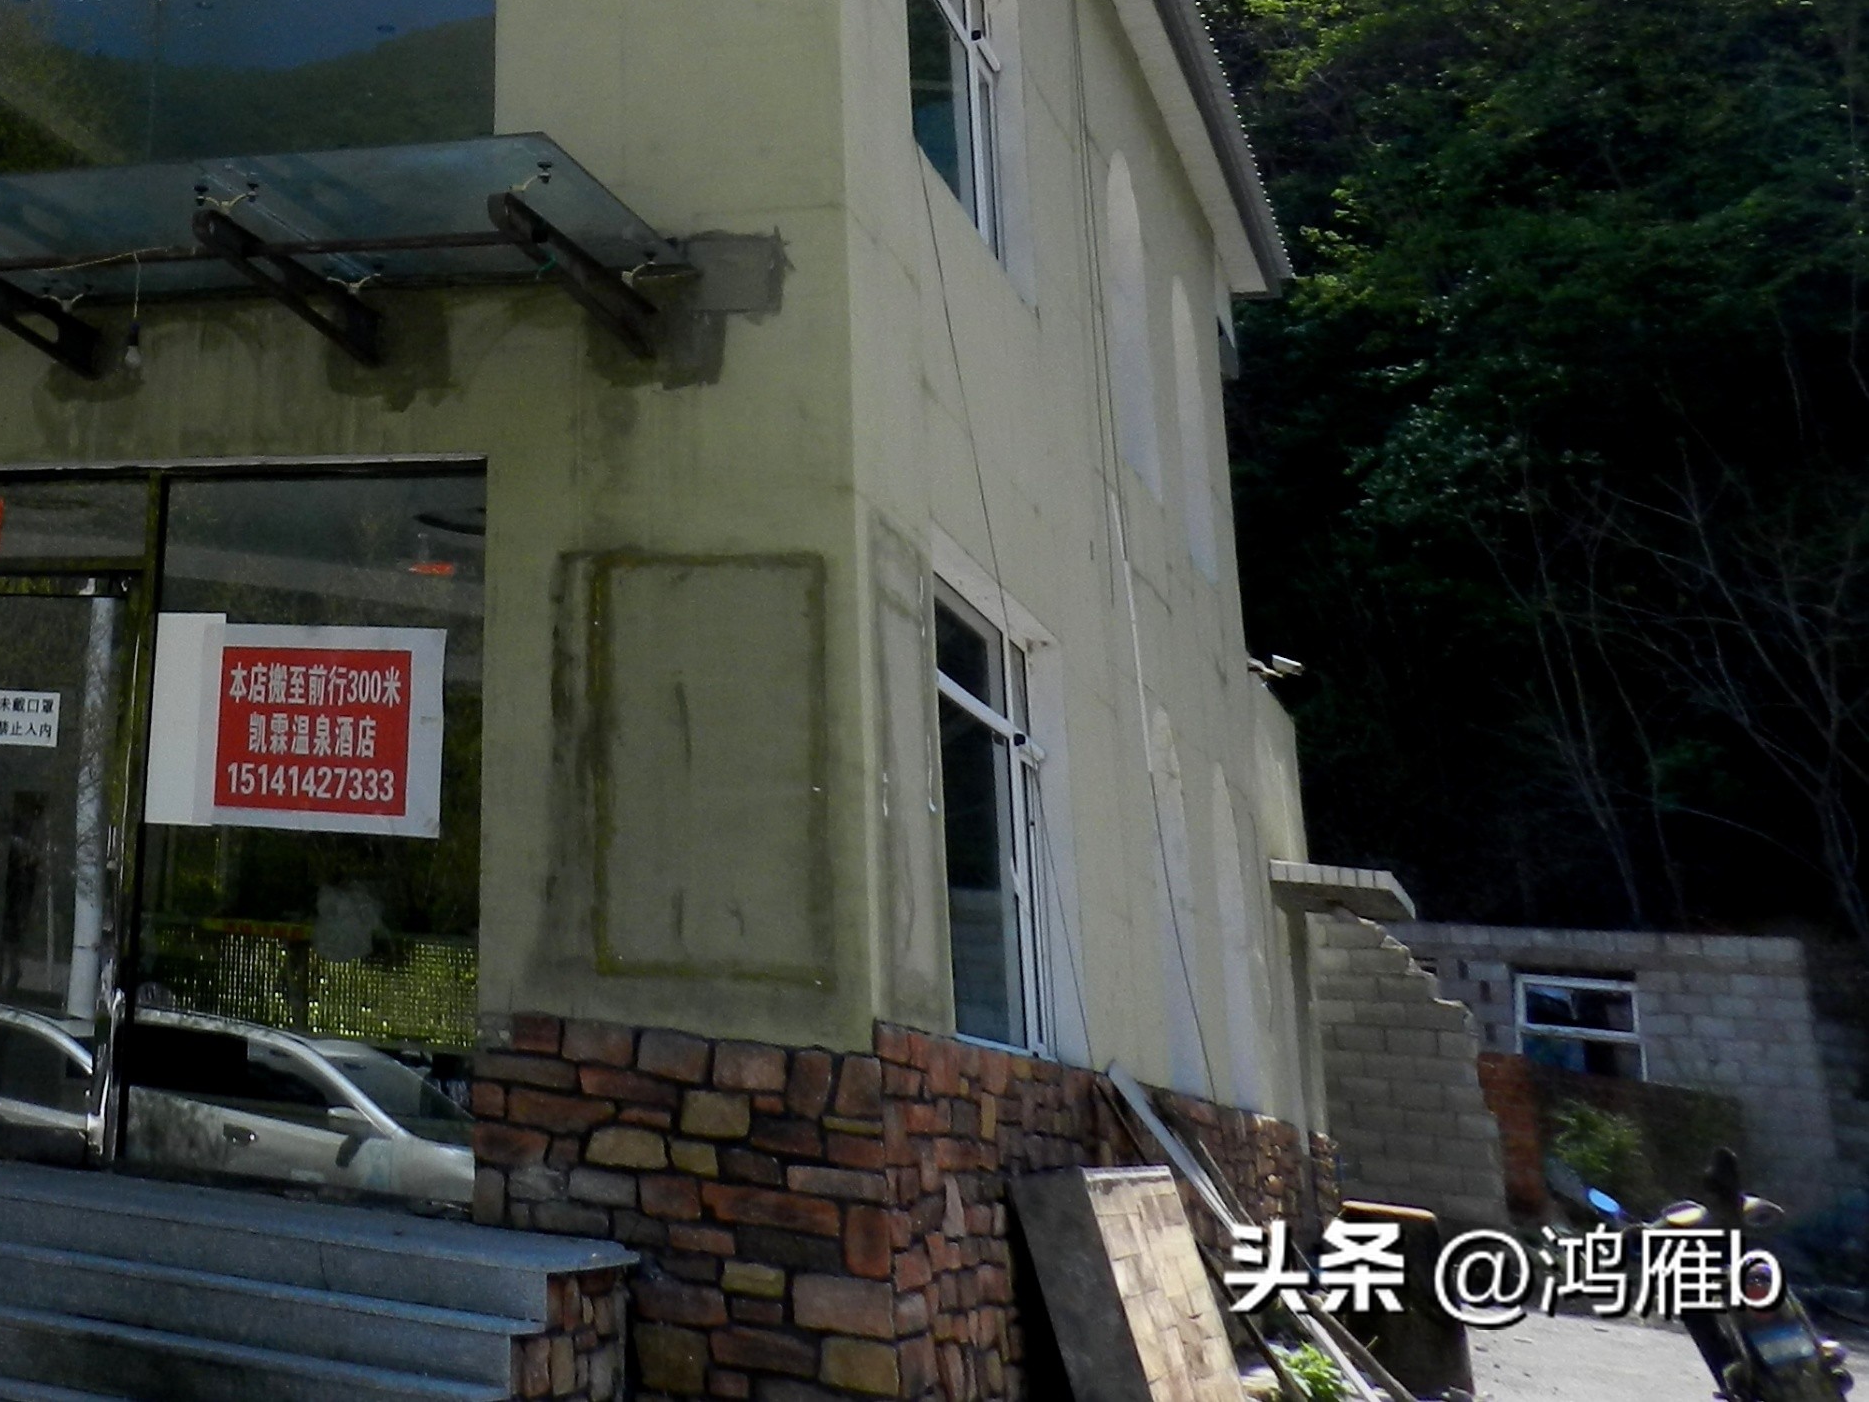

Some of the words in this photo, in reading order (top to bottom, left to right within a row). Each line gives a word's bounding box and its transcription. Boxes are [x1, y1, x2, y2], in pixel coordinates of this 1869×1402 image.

[229, 662, 402, 708] 本店搬至前行300米
[248, 711, 377, 758] 凯霖温泉酒店
[227, 762, 395, 802] 15141427333
